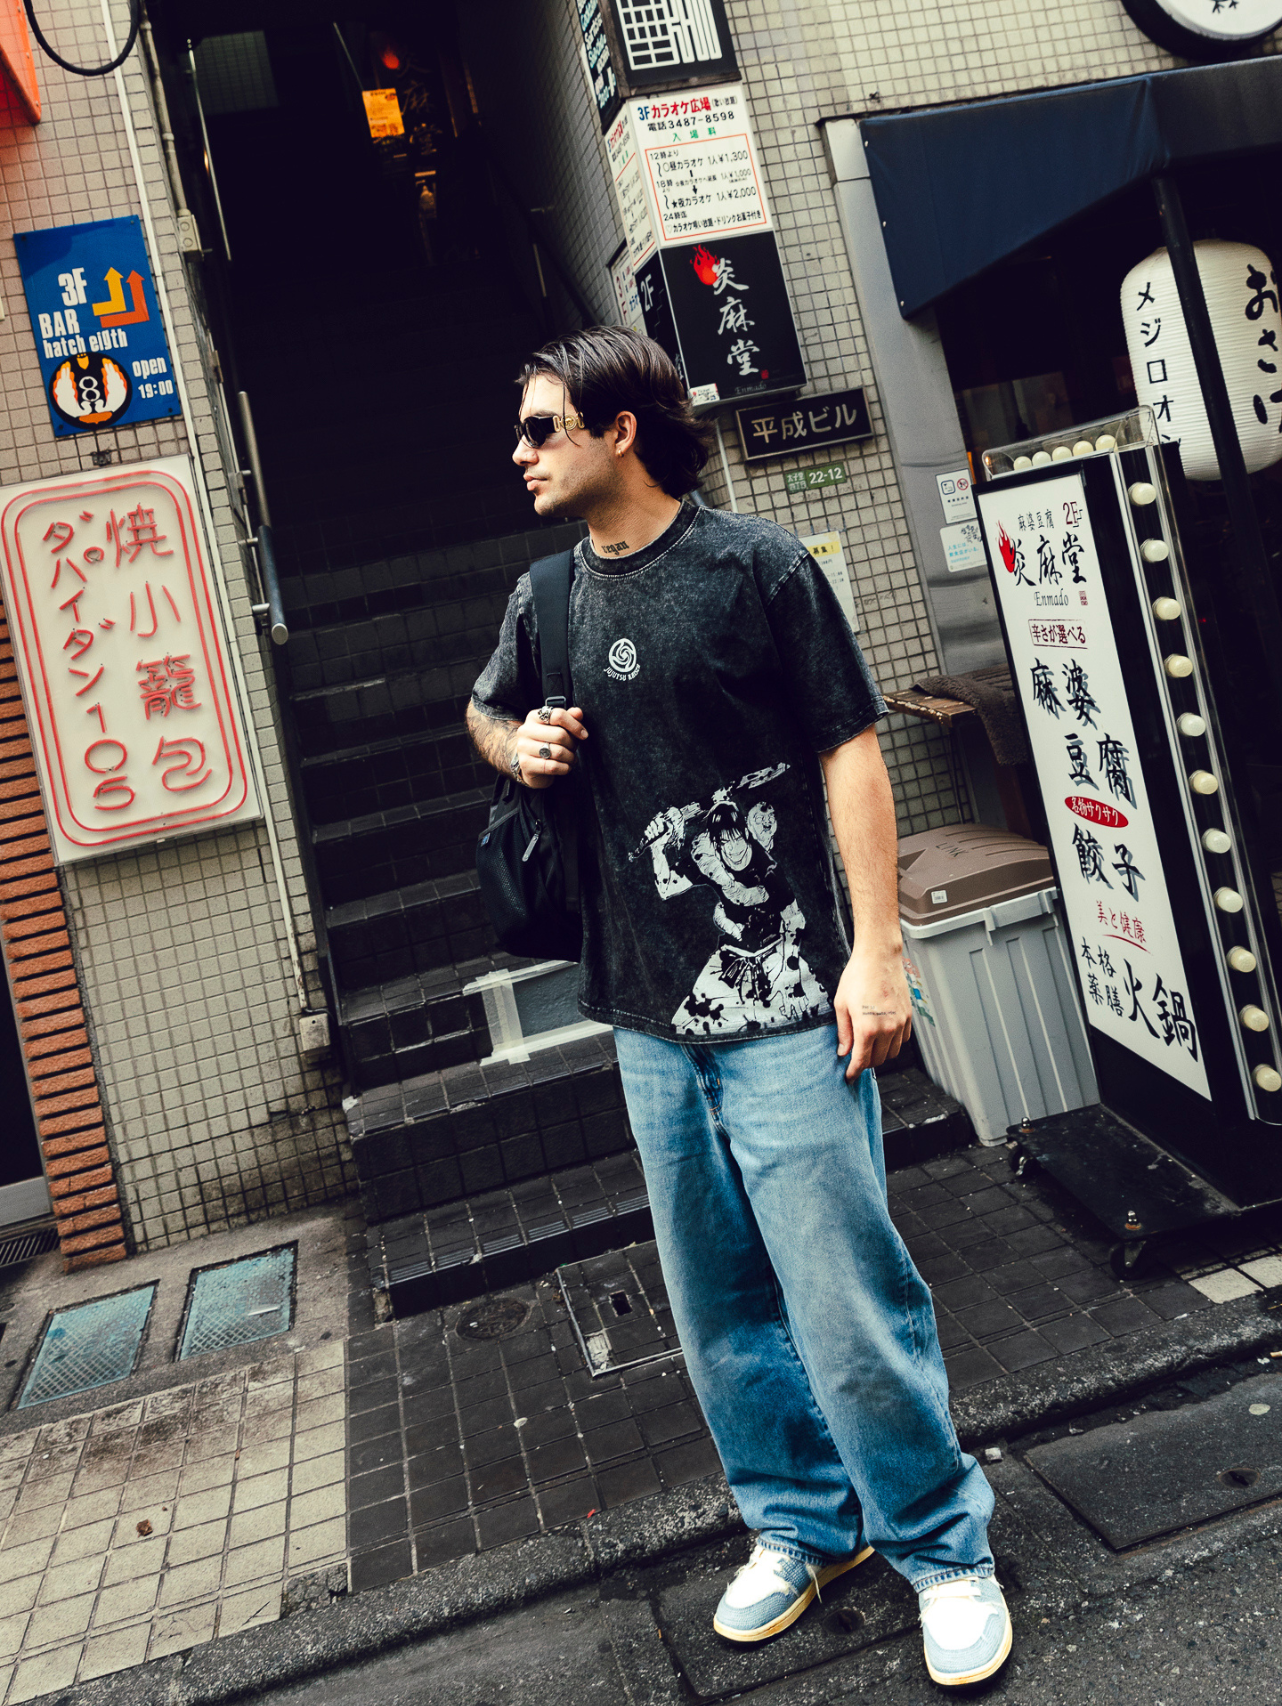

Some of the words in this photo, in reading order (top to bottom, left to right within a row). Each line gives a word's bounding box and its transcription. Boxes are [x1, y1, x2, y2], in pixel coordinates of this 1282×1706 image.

[638, 106, 650, 121] 3F
[651, 96, 711, 119] カラオケ広場
[672, 126, 716, 142] 入場料
[57, 267, 88, 307] 3F
[639, 273, 656, 313] 2F
[37, 308, 81, 339] BAR
[711, 257, 761, 376] 炎麻堂
[42, 334, 87, 359] hatch
[88, 328, 129, 353] eigth
[1136, 281, 1182, 446] メジロオ
[131, 357, 168, 379] open
[78, 375, 101, 403] 8
[138, 379, 174, 399] 19:00
[751, 404, 857, 444] 平成ビル
[809, 467, 843, 484] 22-12
[1017, 509, 1055, 531] 麻婆豆腐
[1009, 531, 1087, 587] 炎麻堂
[1034, 588, 1069, 606] Enmado
[105, 503, 214, 792] 焼小籠包
[1032, 624, 1086, 644] 辛さが選べる
[1030, 657, 1101, 730] 麻婆
[1064, 732, 1138, 810] 豆腐
[1072, 822, 1146, 902] 餃子
[1096, 900, 1147, 943] 美と健康
[1081, 936, 1117, 977] 本格
[1087, 972, 1124, 1017] 薬膳
[1123, 958, 1199, 1063] 火鍋
